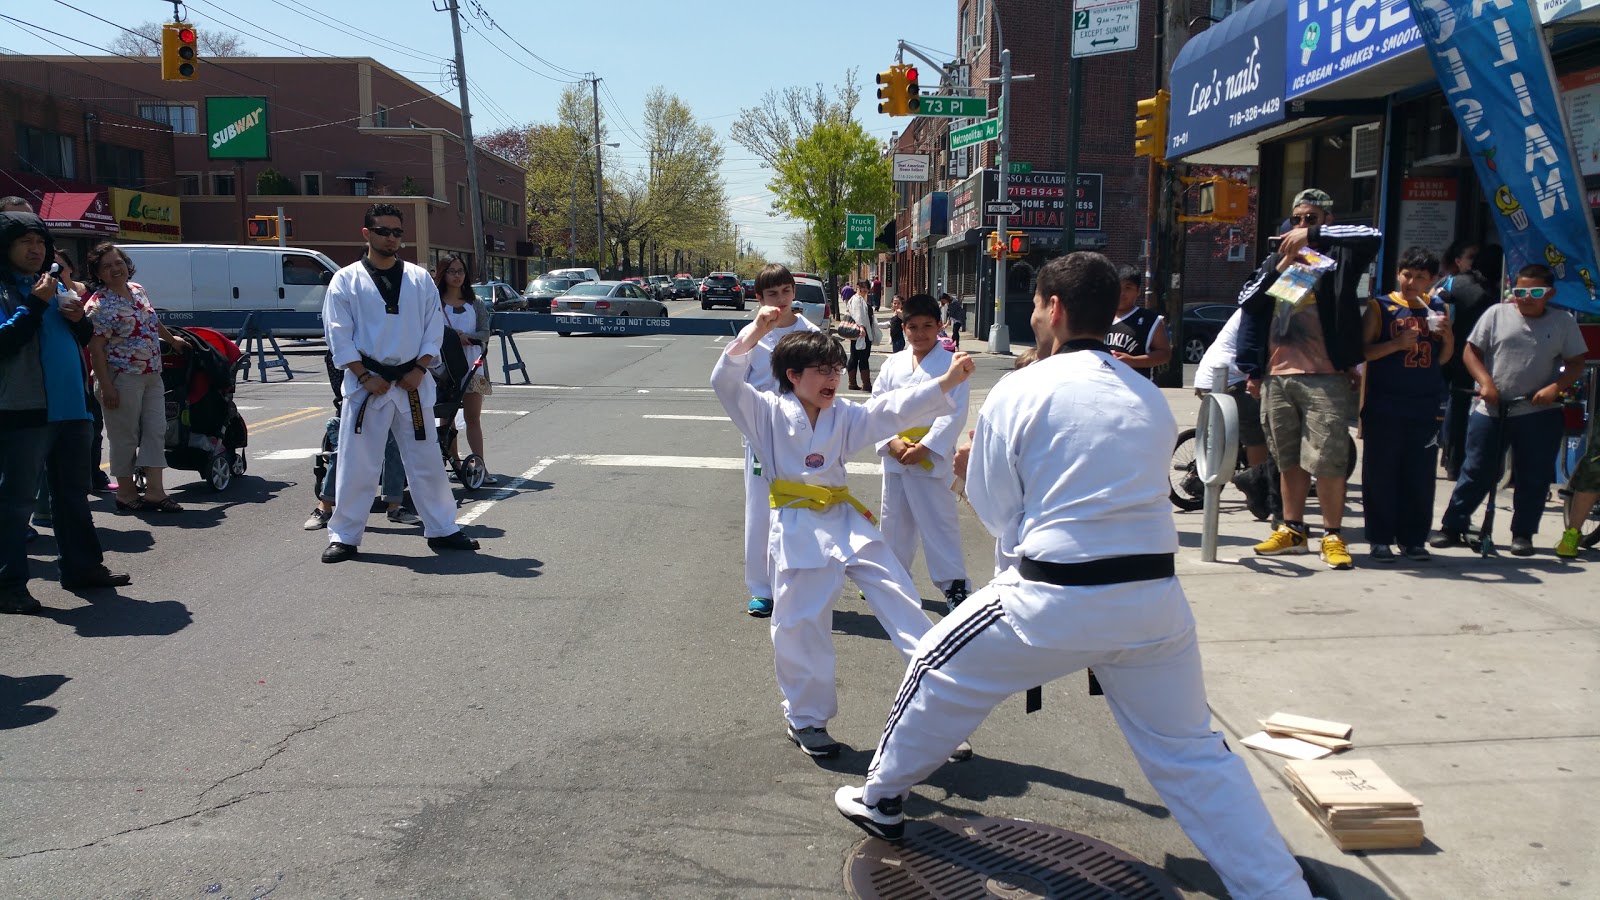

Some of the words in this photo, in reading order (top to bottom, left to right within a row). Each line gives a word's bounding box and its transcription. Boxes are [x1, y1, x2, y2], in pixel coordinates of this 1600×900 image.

[1077, 11, 1087, 29] 2
[1331, 0, 1410, 54] ICE
[1080, 28, 1104, 39] EXCEPT
[1105, 25, 1131, 35] SUNDAY
[1187, 68, 1222, 117] Lee's
[1224, 35, 1261, 102] nails
[1292, 74, 1305, 91] ICE
[1305, 62, 1334, 85] CREAM
[1339, 44, 1375, 72] SHAKES
[925, 100, 944, 113] 73
[950, 101, 964, 114] Pl
[1229, 96, 1281, 129] 718-326-4429
[211, 106, 263, 150] SUBWAY
[952, 128, 985, 147] Metropolitan
[985, 124, 995, 137] Av
[1172, 131, 1189, 149] 73-01
[1013, 163, 1021, 173] 73
[993, 173, 1022, 183] RSSO
[1033, 175, 1081, 185] CALABRE
[1007, 187, 1080, 198] 718-894-53
[1021, 200, 1045, 209] HOME
[1053, 200, 1094, 210] BUESS
[987, 210, 1097, 228] ISURACE
[157, 312, 166, 320] OT
[169, 312, 194, 320] CROSS
[555, 316, 582, 325] POLICE
[587, 317, 604, 326] LINE
[616, 318, 626, 327] DO
[628, 318, 643, 327] NOT
[646, 319, 671, 328] CROSS
[1103, 332, 1139, 354] OKLYN
[1404, 341, 1432, 368] 23
